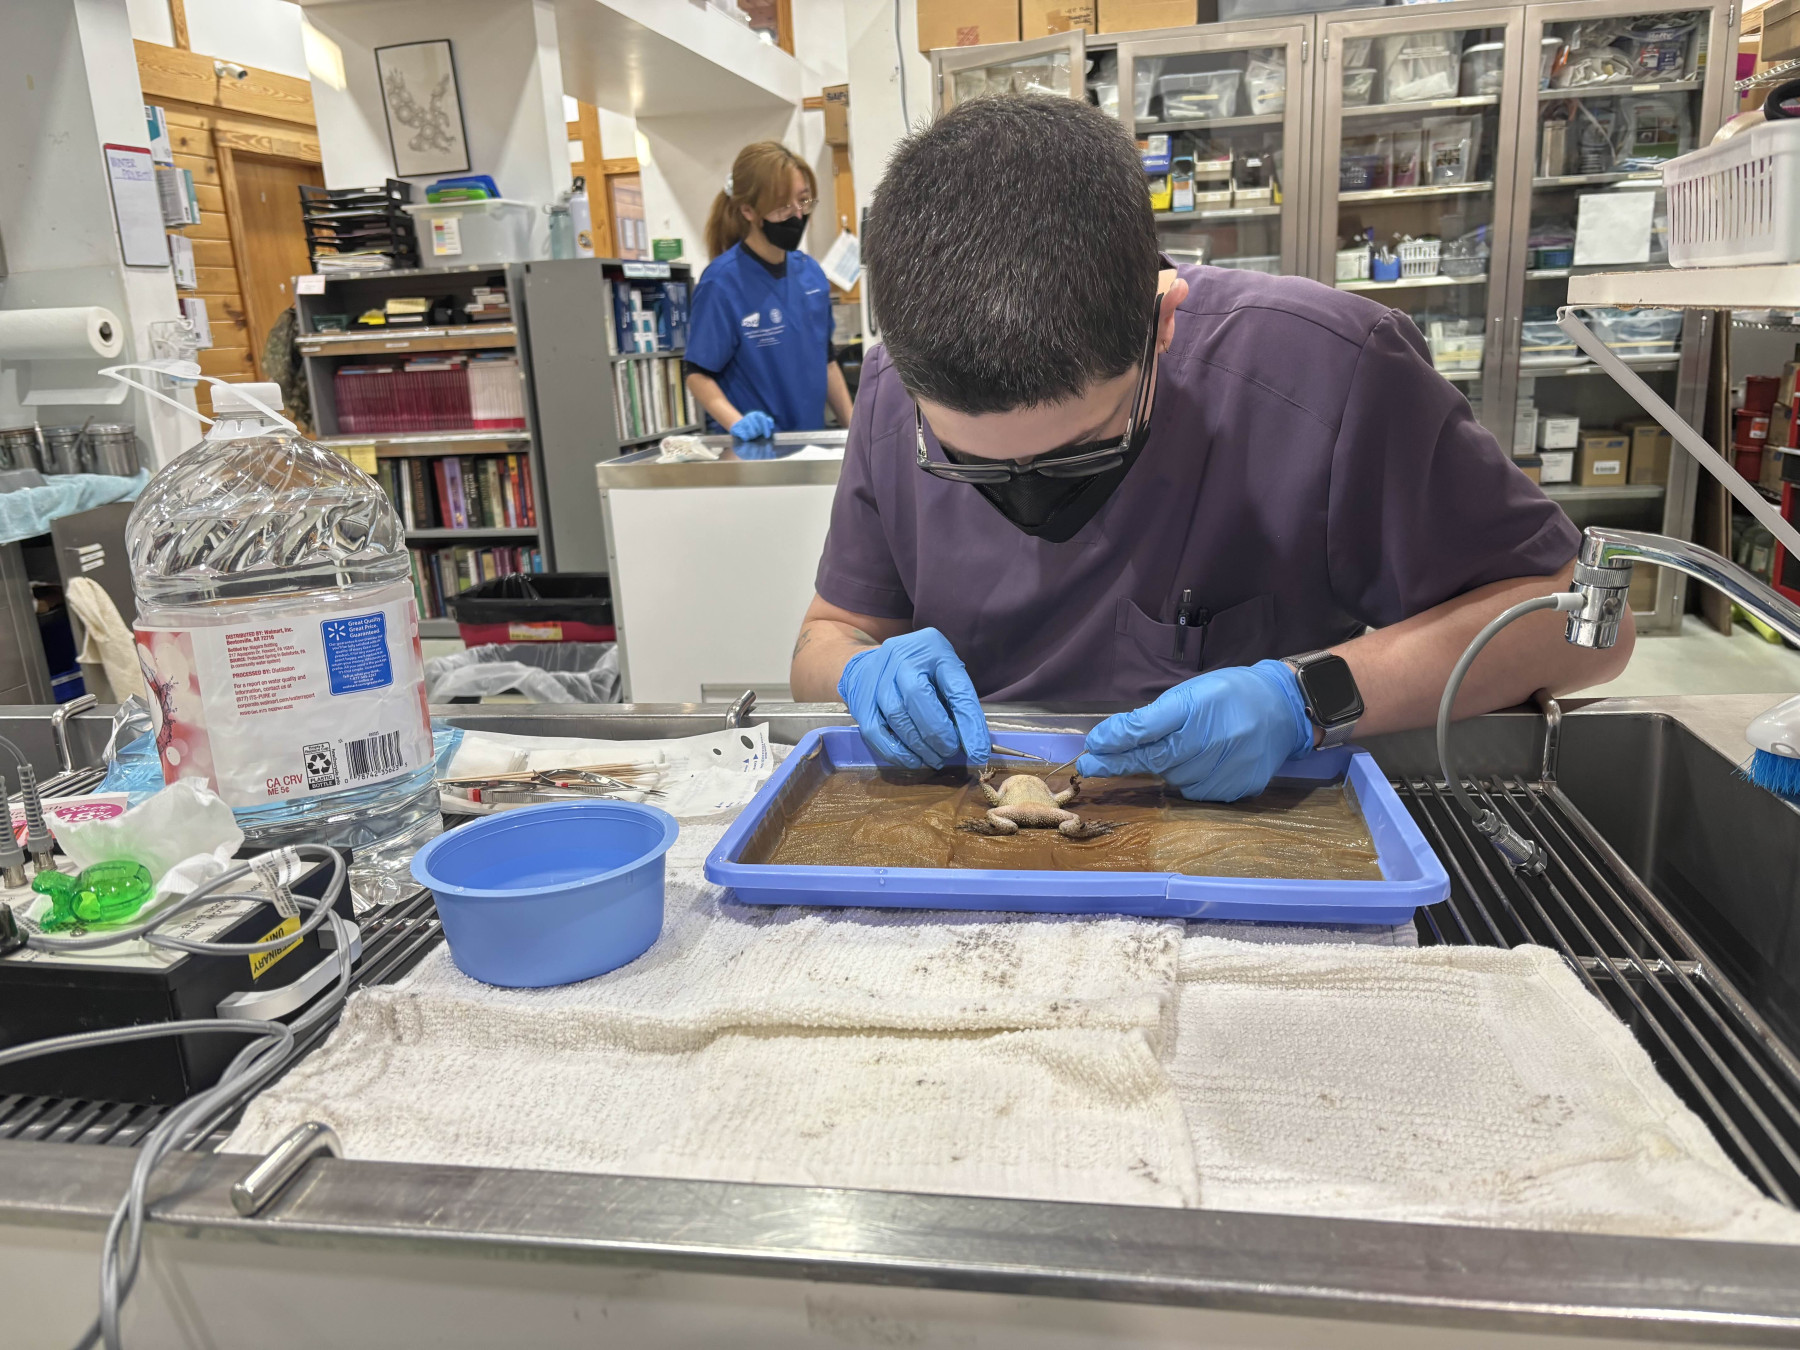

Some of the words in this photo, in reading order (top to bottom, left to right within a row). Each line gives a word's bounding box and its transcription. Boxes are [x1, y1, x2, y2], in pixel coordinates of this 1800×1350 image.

[225, 632, 255, 640] DISTRIBUTED
[350, 629, 380, 638] Guaranteed.
[233, 670, 261, 678] PROCESSED
[235, 688, 262, 696] information,
[310, 774, 333, 783] PLASTIC
[357, 771, 378, 780] 78742
[266, 778, 280, 789] CA
[283, 774, 303, 786] CRV
[311, 780, 333, 789] BOTTLE
[267, 788, 279, 796] ME
